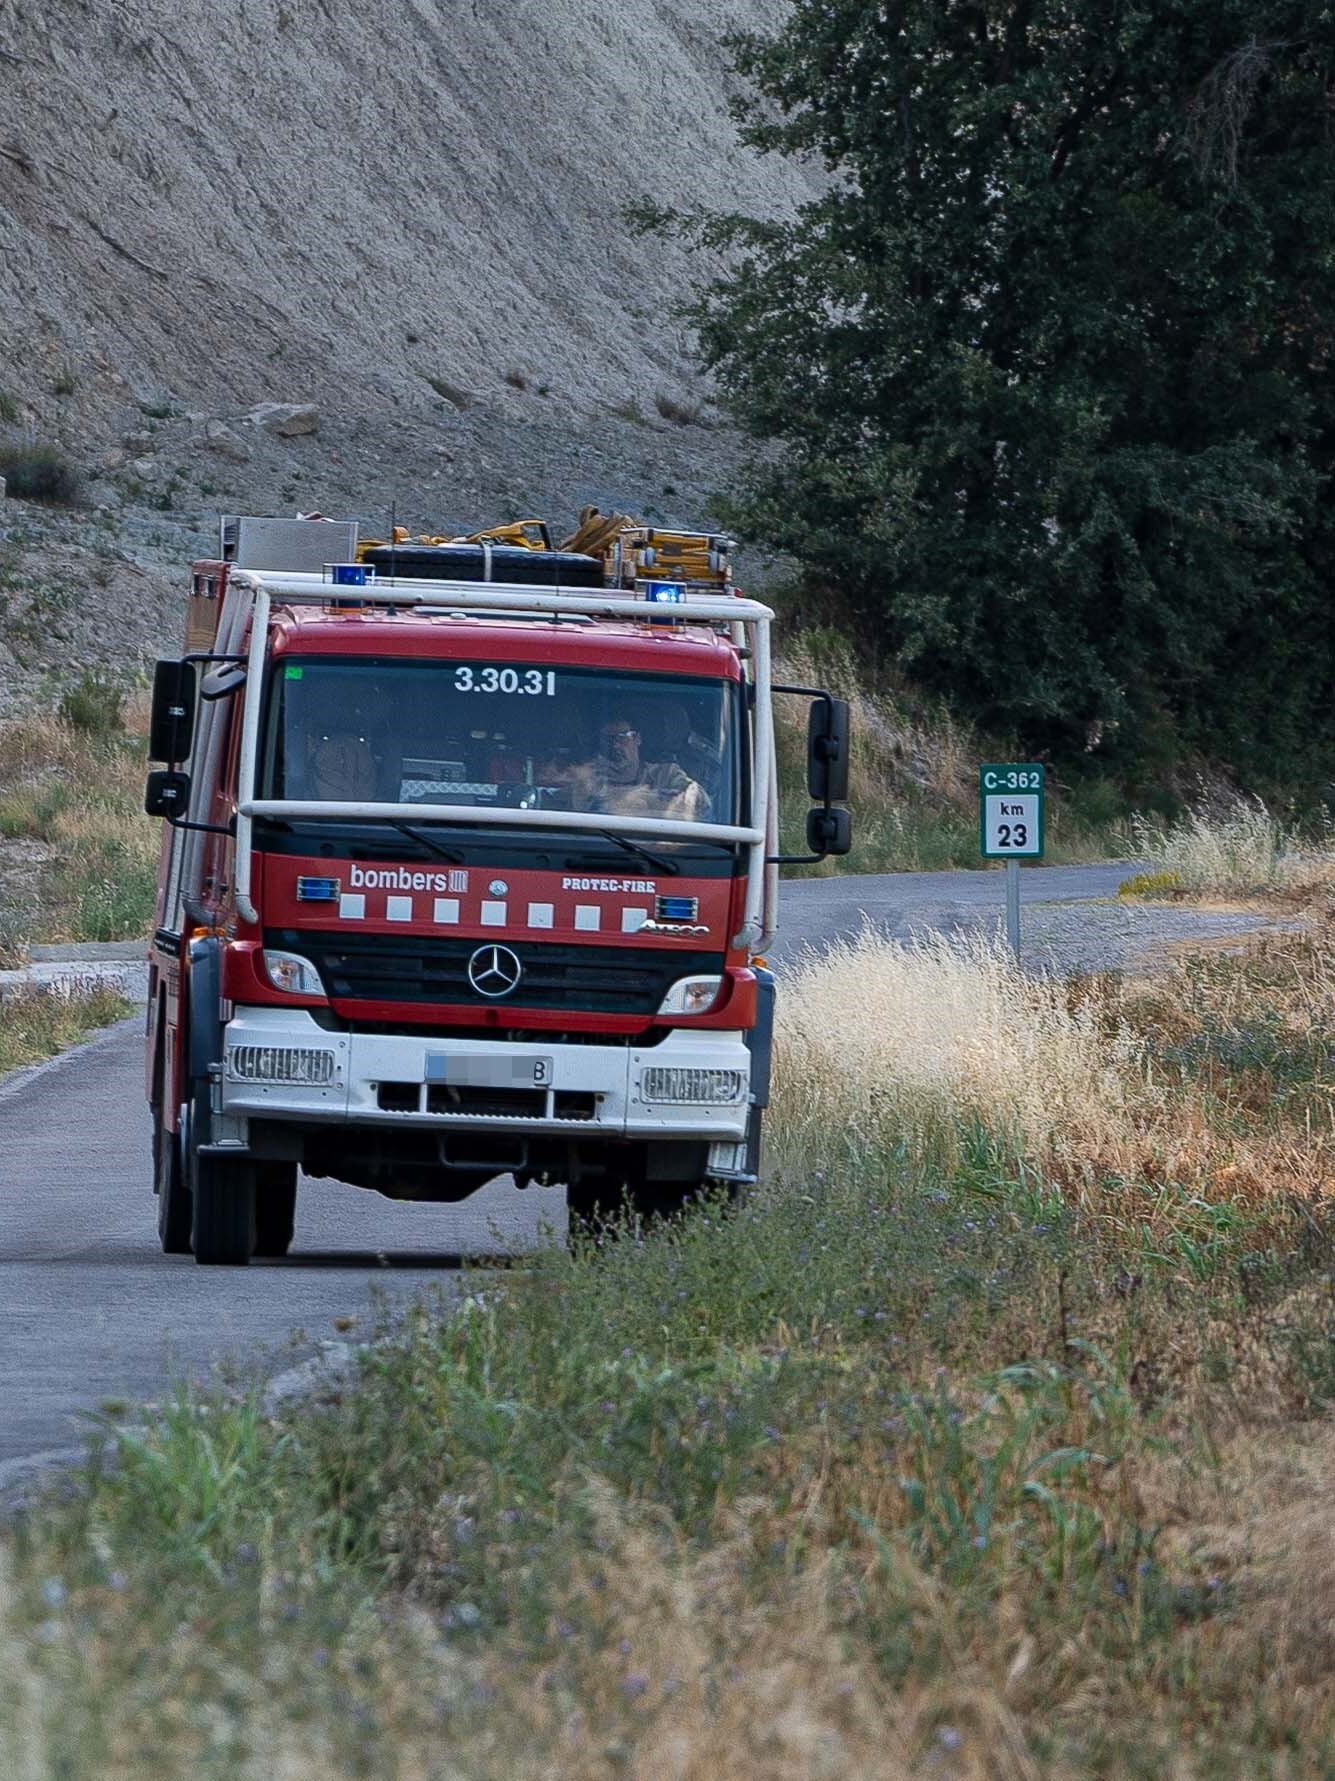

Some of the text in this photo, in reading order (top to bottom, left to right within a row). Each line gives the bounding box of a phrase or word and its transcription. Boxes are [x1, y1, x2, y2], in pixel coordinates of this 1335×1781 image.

[454, 666, 556, 696] 3.30.31
[984, 772, 1041, 789] C-362
[1000, 801, 1024, 816] km
[997, 824, 1027, 847] 23
[350, 864, 448, 892] bombers
[562, 877, 656, 893] PROTEC-FIRE
